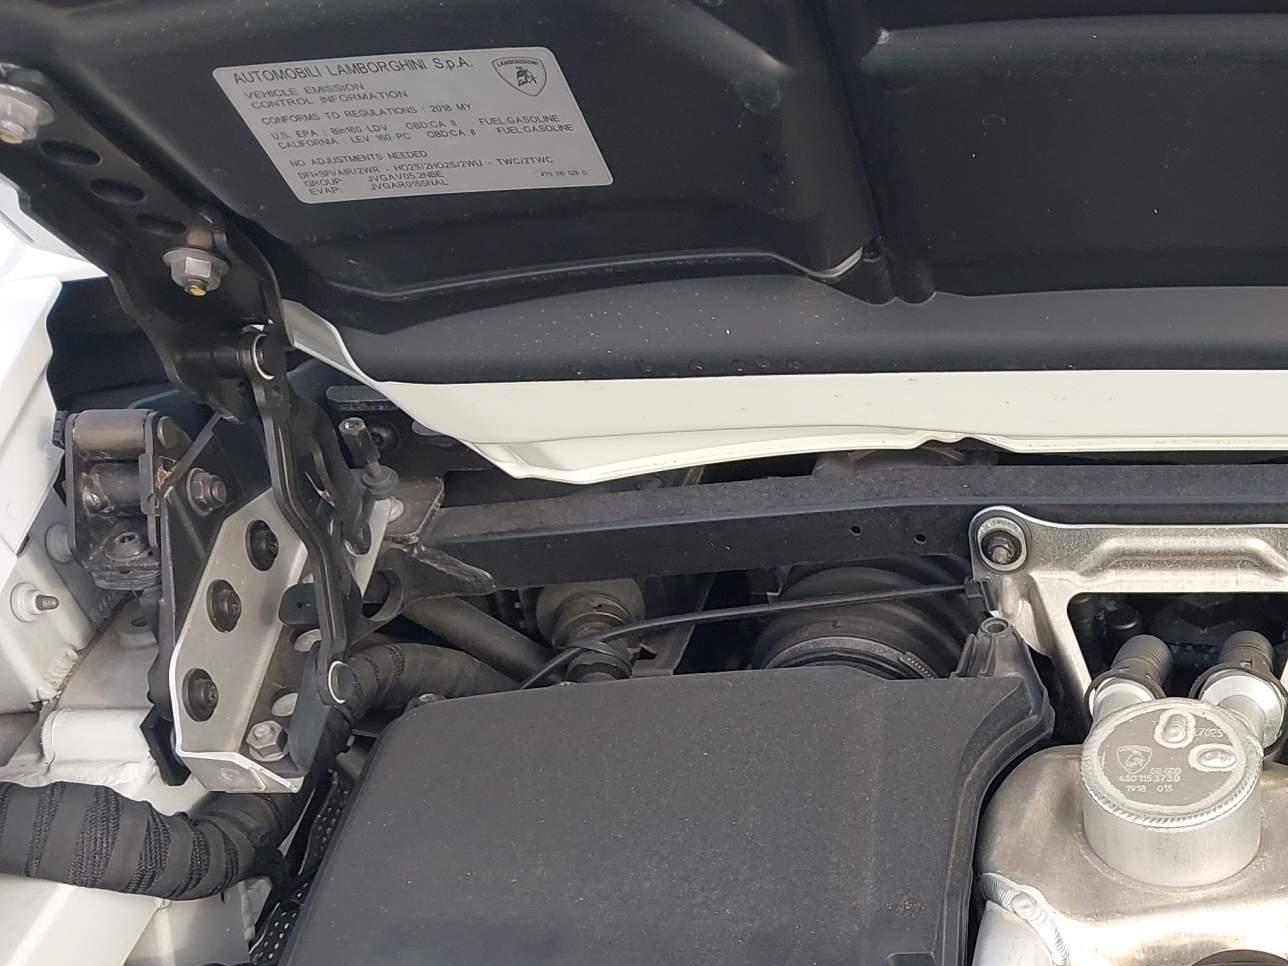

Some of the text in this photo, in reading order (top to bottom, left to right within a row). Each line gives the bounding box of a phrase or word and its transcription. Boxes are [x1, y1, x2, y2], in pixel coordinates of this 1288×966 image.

[233, 56, 473, 84] AUTOMOBILI LAMBORGHINI S.p.A.
[243, 83, 365, 99] VEHICLE EMISSION
[251, 90, 408, 110] CONTROL INFORMATION
[261, 111, 320, 125] CONFORMS
[325, 110, 341, 120] TO
[344, 106, 418, 119] REGULATIONS
[429, 104, 452, 113] 2018
[456, 103, 471, 112] MY
[296, 128, 319, 138] EPA
[367, 124, 388, 133] LDV
[277, 138, 339, 150] CALIFORNIA
[350, 135, 370, 144] LEV
[395, 132, 411, 141] PC
[289, 150, 428, 168] NO ADJUSTMENTS NEEDED
[496, 156, 554, 166] TWC/2TWC
